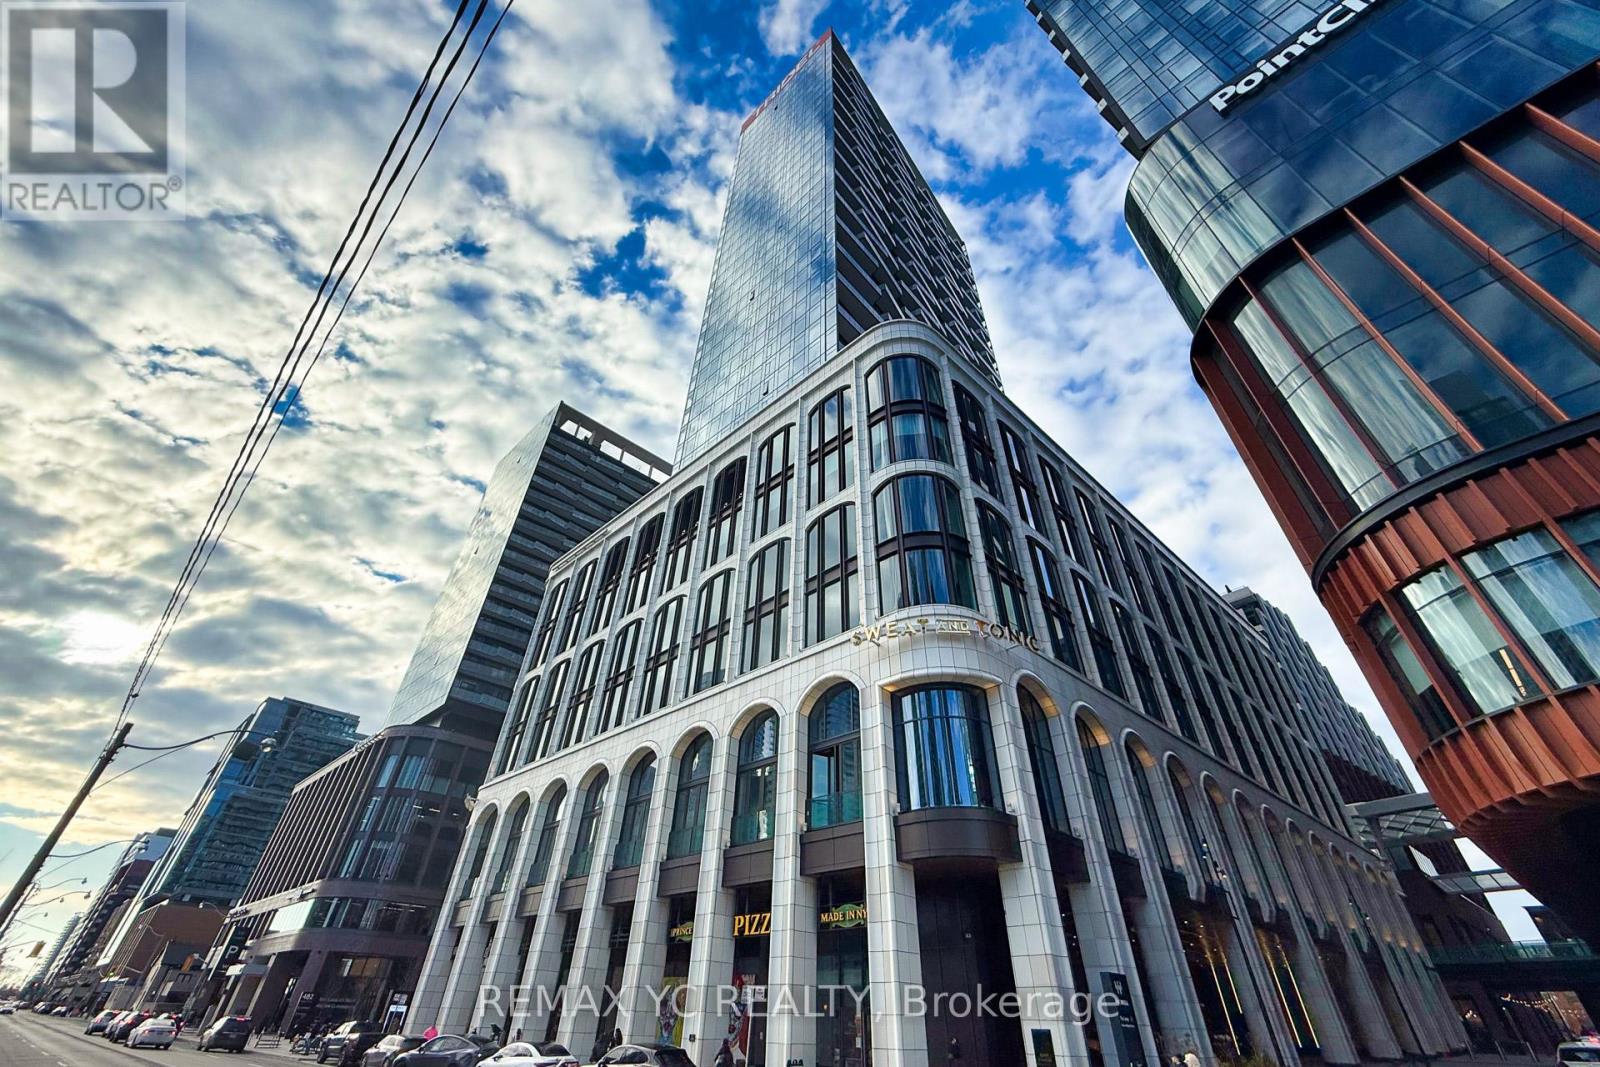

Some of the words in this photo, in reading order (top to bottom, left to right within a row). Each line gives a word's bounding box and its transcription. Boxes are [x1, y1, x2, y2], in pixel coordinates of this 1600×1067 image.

[1208, 0, 1376, 112] PointCl
[852, 618, 929, 647] SWEAT
[937, 619, 970, 634] AND
[975, 620, 1041, 652] TONIC
[820, 911, 845, 923] MADE
[846, 909, 855, 920] IN
[225, 945, 239, 960] P
